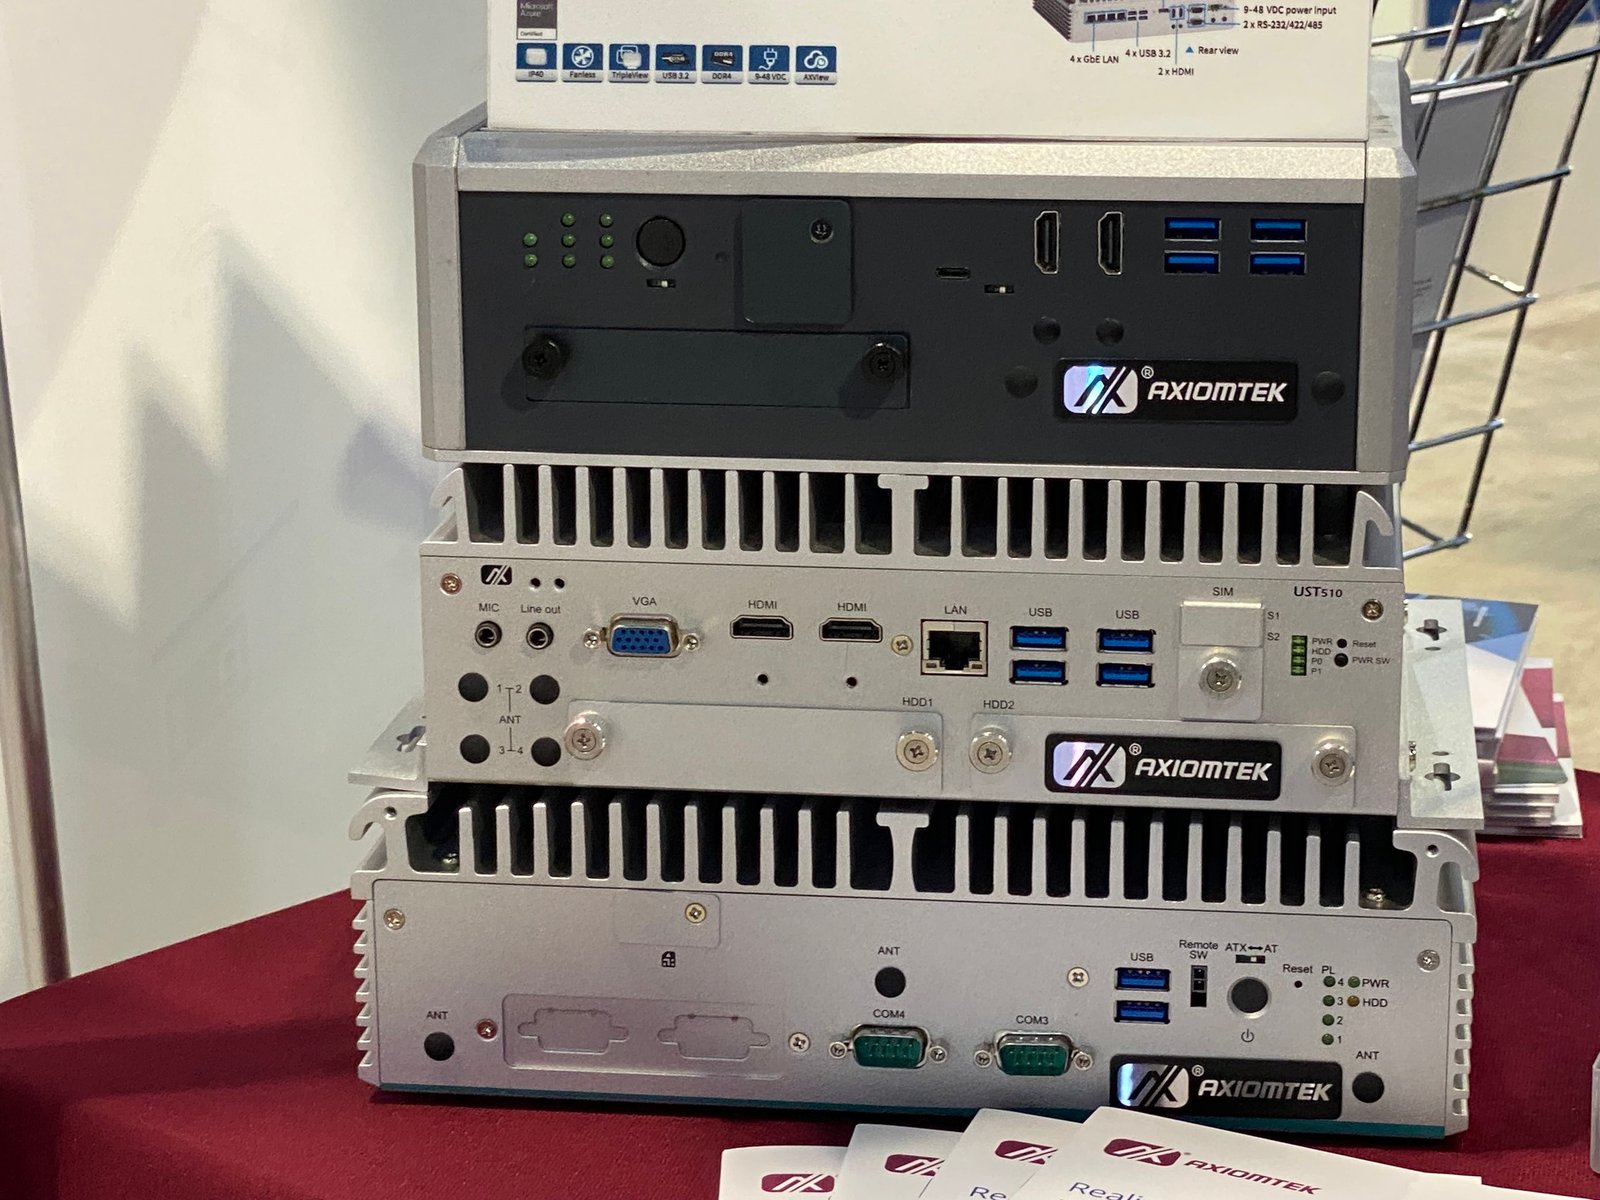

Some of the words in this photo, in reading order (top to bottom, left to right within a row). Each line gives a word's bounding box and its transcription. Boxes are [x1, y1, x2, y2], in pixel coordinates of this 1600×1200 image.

[1243, 6, 1263, 14] 9-48
[1267, 6, 1283, 14] VDC
[1286, 7, 1310, 15] power
[1243, 21, 1248, 29] 2
[1257, 21, 1323, 30] RS-232/422/485
[1139, 50, 1157, 58] USB
[1158, 50, 1171, 58] 3.2
[1198, 46, 1217, 55] Rear
[1220, 47, 1239, 55] view
[1070, 55, 1075, 63] 4
[1083, 55, 1100, 63] GbE
[1103, 56, 1119, 64] LAN
[612, 72, 648, 81] TripleView
[1158, 68, 1163, 76] 2
[1171, 68, 1195, 76] HDMI
[1147, 381, 1287, 402] AXIOMTEK
[1211, 586, 1234, 597] SIM
[1293, 585, 1343, 598] UST510
[632, 596, 658, 606] VGA
[747, 599, 778, 610] HDMI
[478, 602, 500, 613] MIC
[520, 604, 542, 614] Line
[545, 605, 561, 615] out
[837, 601, 868, 612] HDMI
[943, 605, 967, 616] LAN
[1028, 607, 1053, 618] USB
[1115, 610, 1140, 620] USB
[1267, 611, 1280, 620] S1
[1267, 632, 1280, 641] S2
[1311, 637, 1333, 645] PWR
[1352, 639, 1377, 648] Reset
[1311, 648, 1331, 656] HDD
[1311, 657, 1323, 665] P0
[1351, 656, 1374, 665] PWR
[1375, 657, 1391, 665] SW
[497, 684, 502, 693] 1
[515, 685, 522, 694] 2
[902, 696, 934, 708] HDD1
[983, 699, 1015, 711] HDD2
[499, 715, 521, 724] ANT
[499, 746, 505, 755] 3
[517, 746, 524, 755] 4
[1134, 758, 1272, 782] AXIOMTEK
[1179, 940, 1219, 950] Remote
[1225, 943, 1247, 952] ATX
[1264, 944, 1278, 953] AT
[878, 946, 900, 956] ANT
[1189, 950, 1208, 960] SW
[1130, 952, 1155, 962] USB
[1282, 963, 1313, 974] Reset
[1321, 965, 1335, 975] PL
[1337, 978, 1345, 987] 4
[1362, 978, 1390, 989] PWR
[1337, 997, 1344, 1006] 3
[1362, 998, 1388, 1008] HDD
[426, 1010, 449, 1020] ANT
[873, 1008, 906, 1019] COM4
[1016, 1014, 1049, 1025] COM3
[1336, 1017, 1344, 1026] 2
[1337, 1036, 1343, 1045] 1
[1355, 1051, 1379, 1061] ANT
[1197, 1078, 1332, 1102] AXIOMTEK
[1184, 1159, 1323, 1196] AXIOMTEK
[1069, 1182, 1143, 1200] Real
